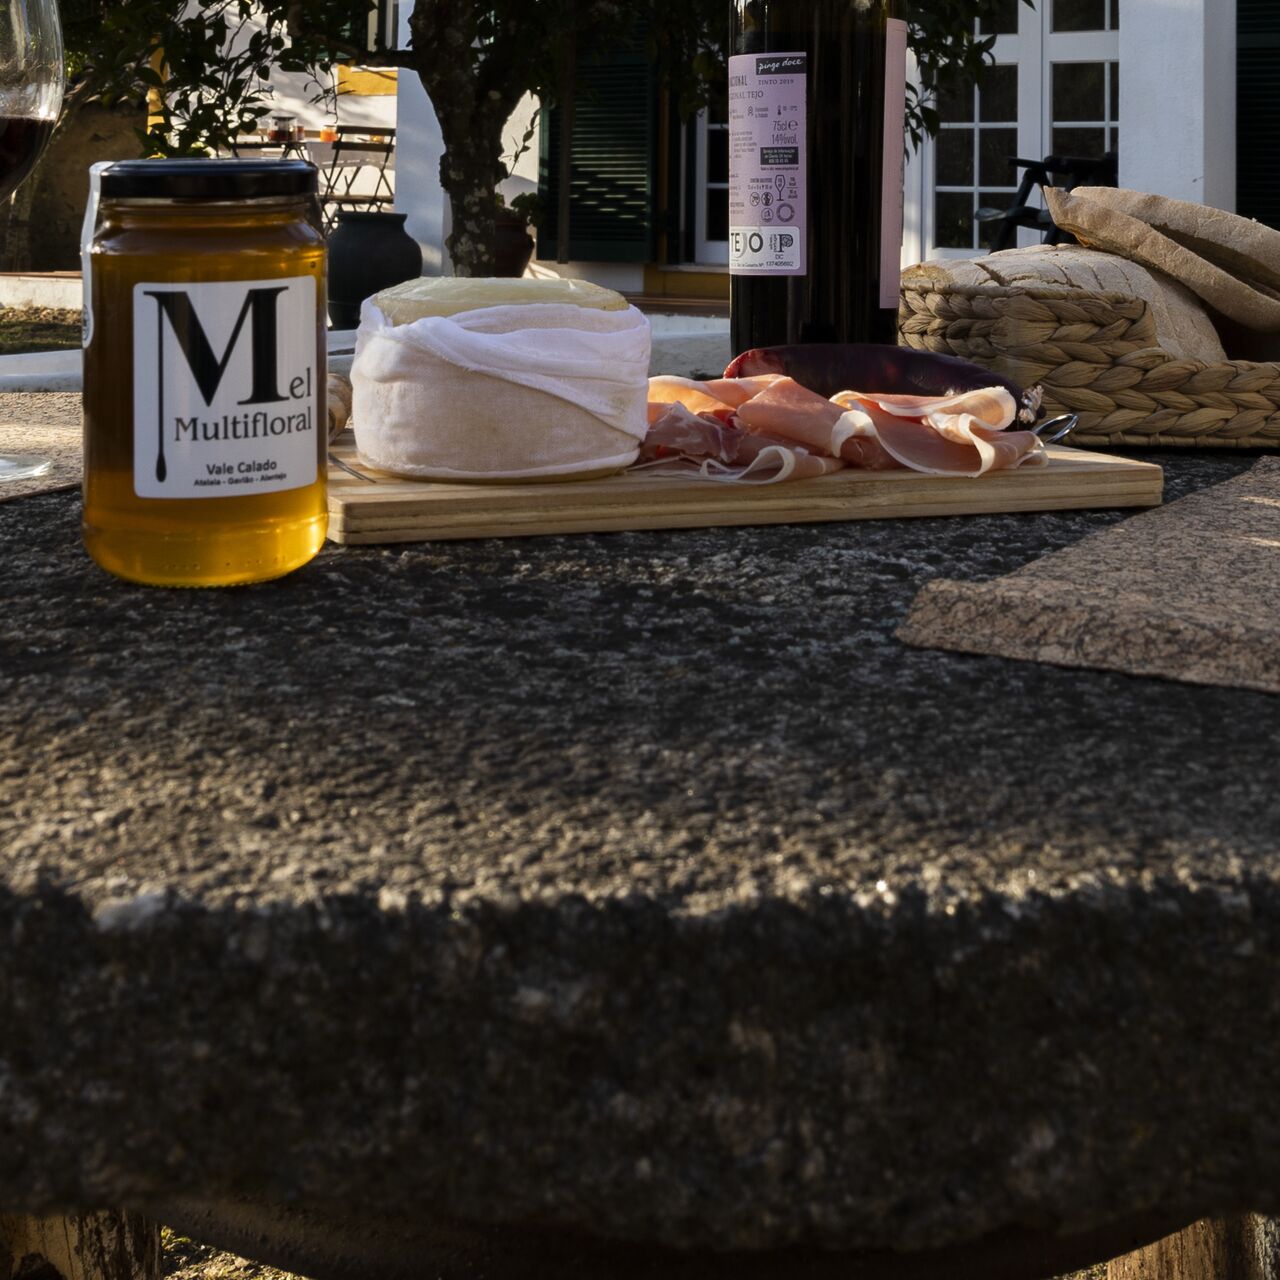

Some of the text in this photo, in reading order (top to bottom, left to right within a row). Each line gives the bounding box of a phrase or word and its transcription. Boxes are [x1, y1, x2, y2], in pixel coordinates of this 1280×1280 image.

[758, 57, 803, 74] pingo doce
[747, 90, 764, 100] TEJO
[143, 286, 312, 408] Mel
[174, 406, 312, 442] Multifloral
[206, 459, 277, 475] Vale Calado
